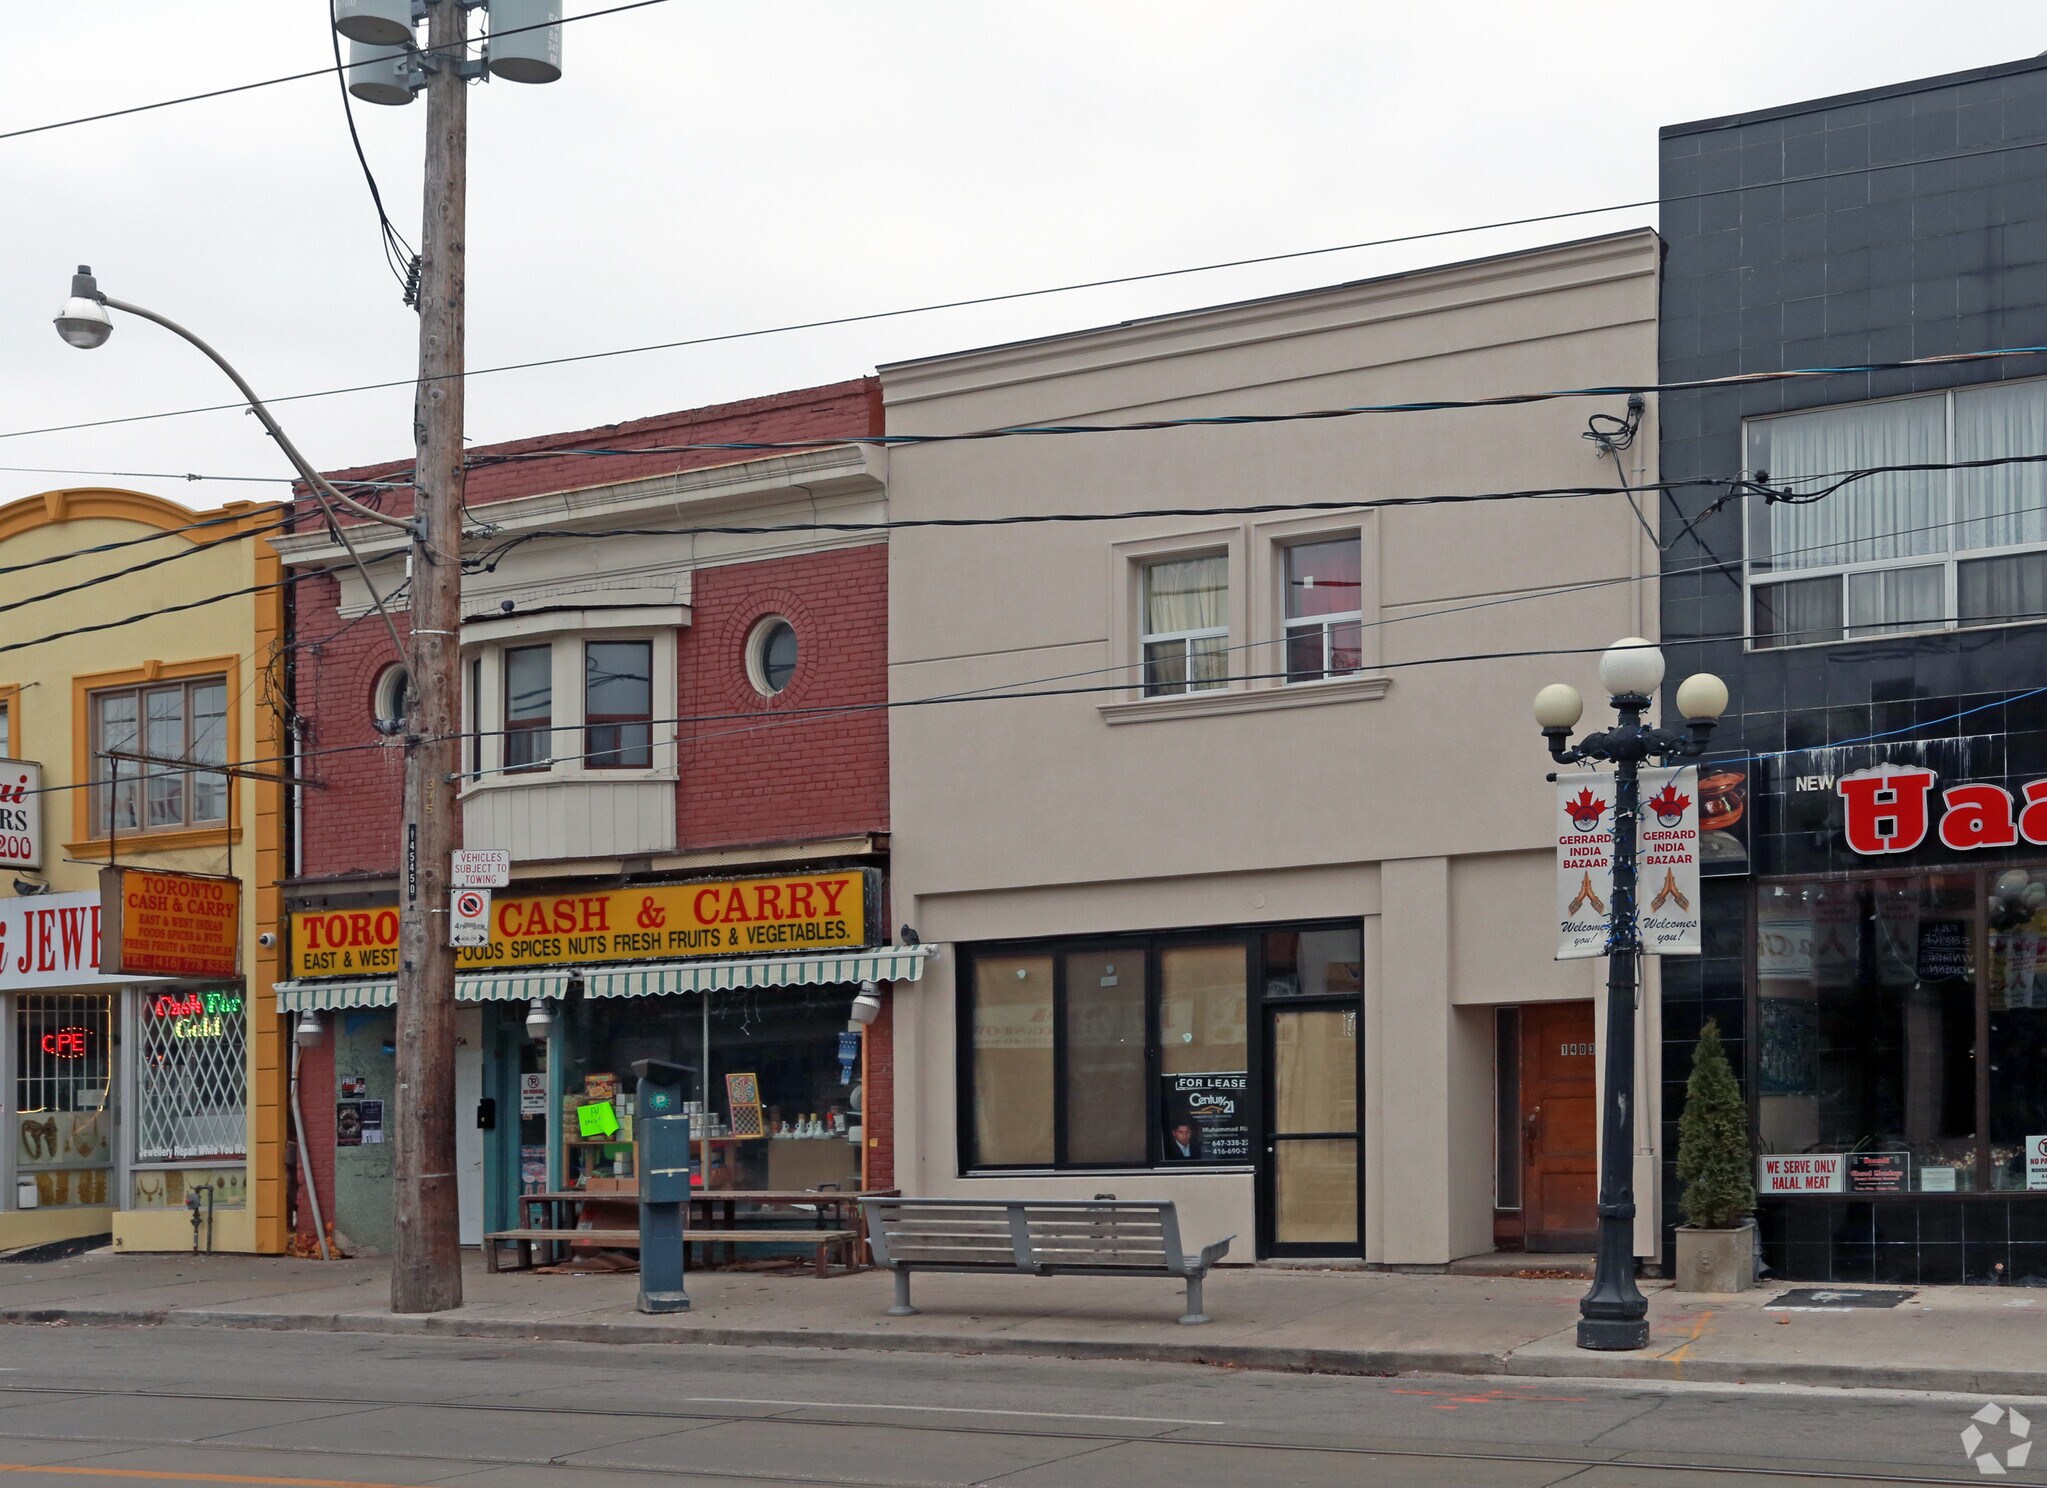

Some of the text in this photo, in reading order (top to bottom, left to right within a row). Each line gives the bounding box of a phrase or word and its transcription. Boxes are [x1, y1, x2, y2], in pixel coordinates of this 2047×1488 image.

[1795, 775, 1835, 792] NEW
[1559, 834, 1612, 845] GERRARD
[1643, 830, 1696, 841] GERRARD
[1569, 847, 1601, 857] INDIA
[1653, 843, 1685, 853] INDIA
[461, 852, 502, 862] VEHICLES
[1563, 858, 1608, 869] BAZAAR
[1646, 855, 1692, 865] BAZAAR
[455, 863, 507, 873] SUBJECT TO
[466, 875, 497, 885] TOWING
[142, 877, 223, 900] TORONTO
[128, 893, 234, 918] CASH & CARRY
[498, 896, 611, 938] CASH
[636, 895, 666, 929] &
[693, 879, 850, 925] CARRY
[139, 913, 223, 932] EAST & WEST INDIAN
[1560, 920, 1604, 933] Welcom
[1642, 917, 1698, 930] Welcomes
[138, 927, 165, 939] FOODS
[167, 929, 194, 941] SPICES
[204, 933, 223, 943] NUTS
[1574, 932, 1599, 948] you!
[1657, 929, 1685, 945] you!
[124, 938, 149, 950] FRESH
[187, 944, 233, 956] VEGETABLES
[304, 920, 850, 970] EAST & WEST FOODS SPICES NUTS FRESH FRUITS & VEGETABLES.
[153, 955, 180, 969] (416)
[185, 957, 203, 970] 778
[207, 960, 232, 972] 8355
[155, 993, 203, 1016] Cash
[1561, 1043, 1595, 1055] 1403
[1179, 1078, 1247, 1088] FOR LEASE
[1189, 1093, 1227, 1107] Century
[1223, 1101, 1235, 1113] 21
[139, 1143, 247, 1159] Jewellery Repair While You Wa
[1212, 1147, 1248, 1155] 416-690-2
[1766, 1159, 1837, 1175] WE SERVE ONLY
[1772, 1175, 1831, 1190] HALAL MEAT
